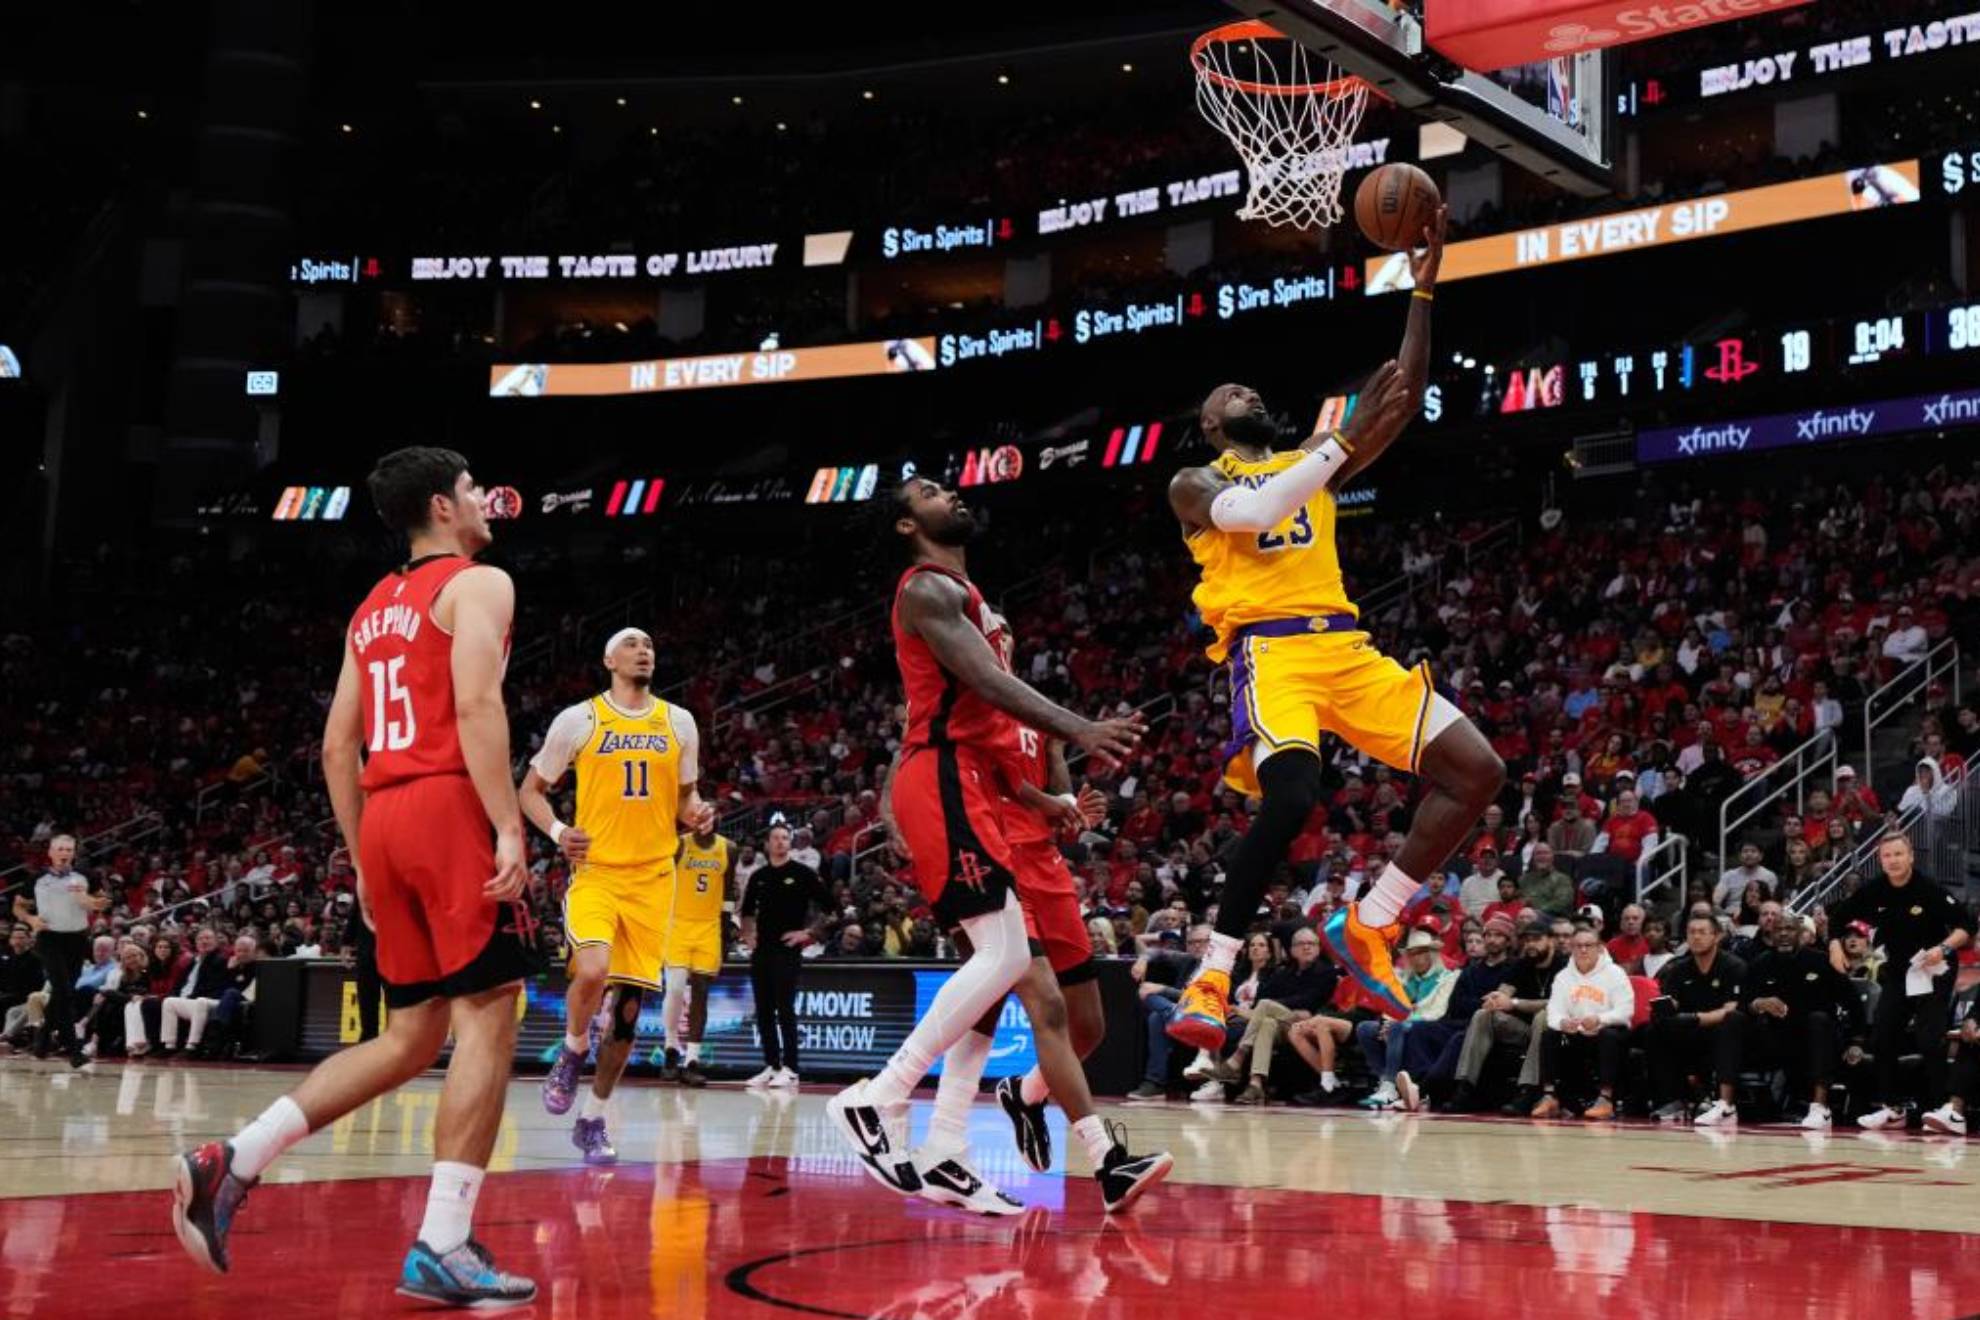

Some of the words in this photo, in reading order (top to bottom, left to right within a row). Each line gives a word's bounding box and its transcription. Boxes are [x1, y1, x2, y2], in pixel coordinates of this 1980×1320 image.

[1700, 52, 1797, 96] ENJOY
[1809, 36, 1872, 73] THE
[1883, 12, 1980, 57] TASTE
[1038, 198, 1108, 234] ENJOY
[1115, 187, 1160, 218] THE
[1166, 169, 1241, 206] TASTE
[902, 228, 933, 252] Sire
[935, 225, 985, 252] Spirits
[1515, 229, 1549, 264] IN
[1560, 207, 1662, 256] EVERY
[1670, 200, 1729, 235] SIP
[300, 258, 350, 284] Spirits
[411, 257, 491, 280] ENJOY
[500, 256, 550, 279] THE
[558, 255, 637, 278] TASTE
[646, 253, 679, 277] OF
[686, 243, 778, 274] LUXURY
[1237, 284, 1270, 311] Sire
[1273, 276, 1326, 307] Spirits
[1093, 305, 1124, 336] Sire
[1126, 301, 1175, 330] Spirits
[958, 333, 987, 360] Sire
[988, 326, 1034, 356] Spirits
[630, 363, 656, 391] IN
[664, 353, 745, 388] EVERY
[751, 350, 797, 379] SIP
[1678, 424, 1751, 455] xfinity
[1797, 408, 1875, 441] xfinity
[368, 654, 417, 752] 15
[596, 730, 669, 754] LAKERS
[623, 760, 649, 797] 11
[696, 873, 708, 892] 5
[806, 990, 873, 1018] MOVIE
[825, 1025, 876, 1052] NOW
